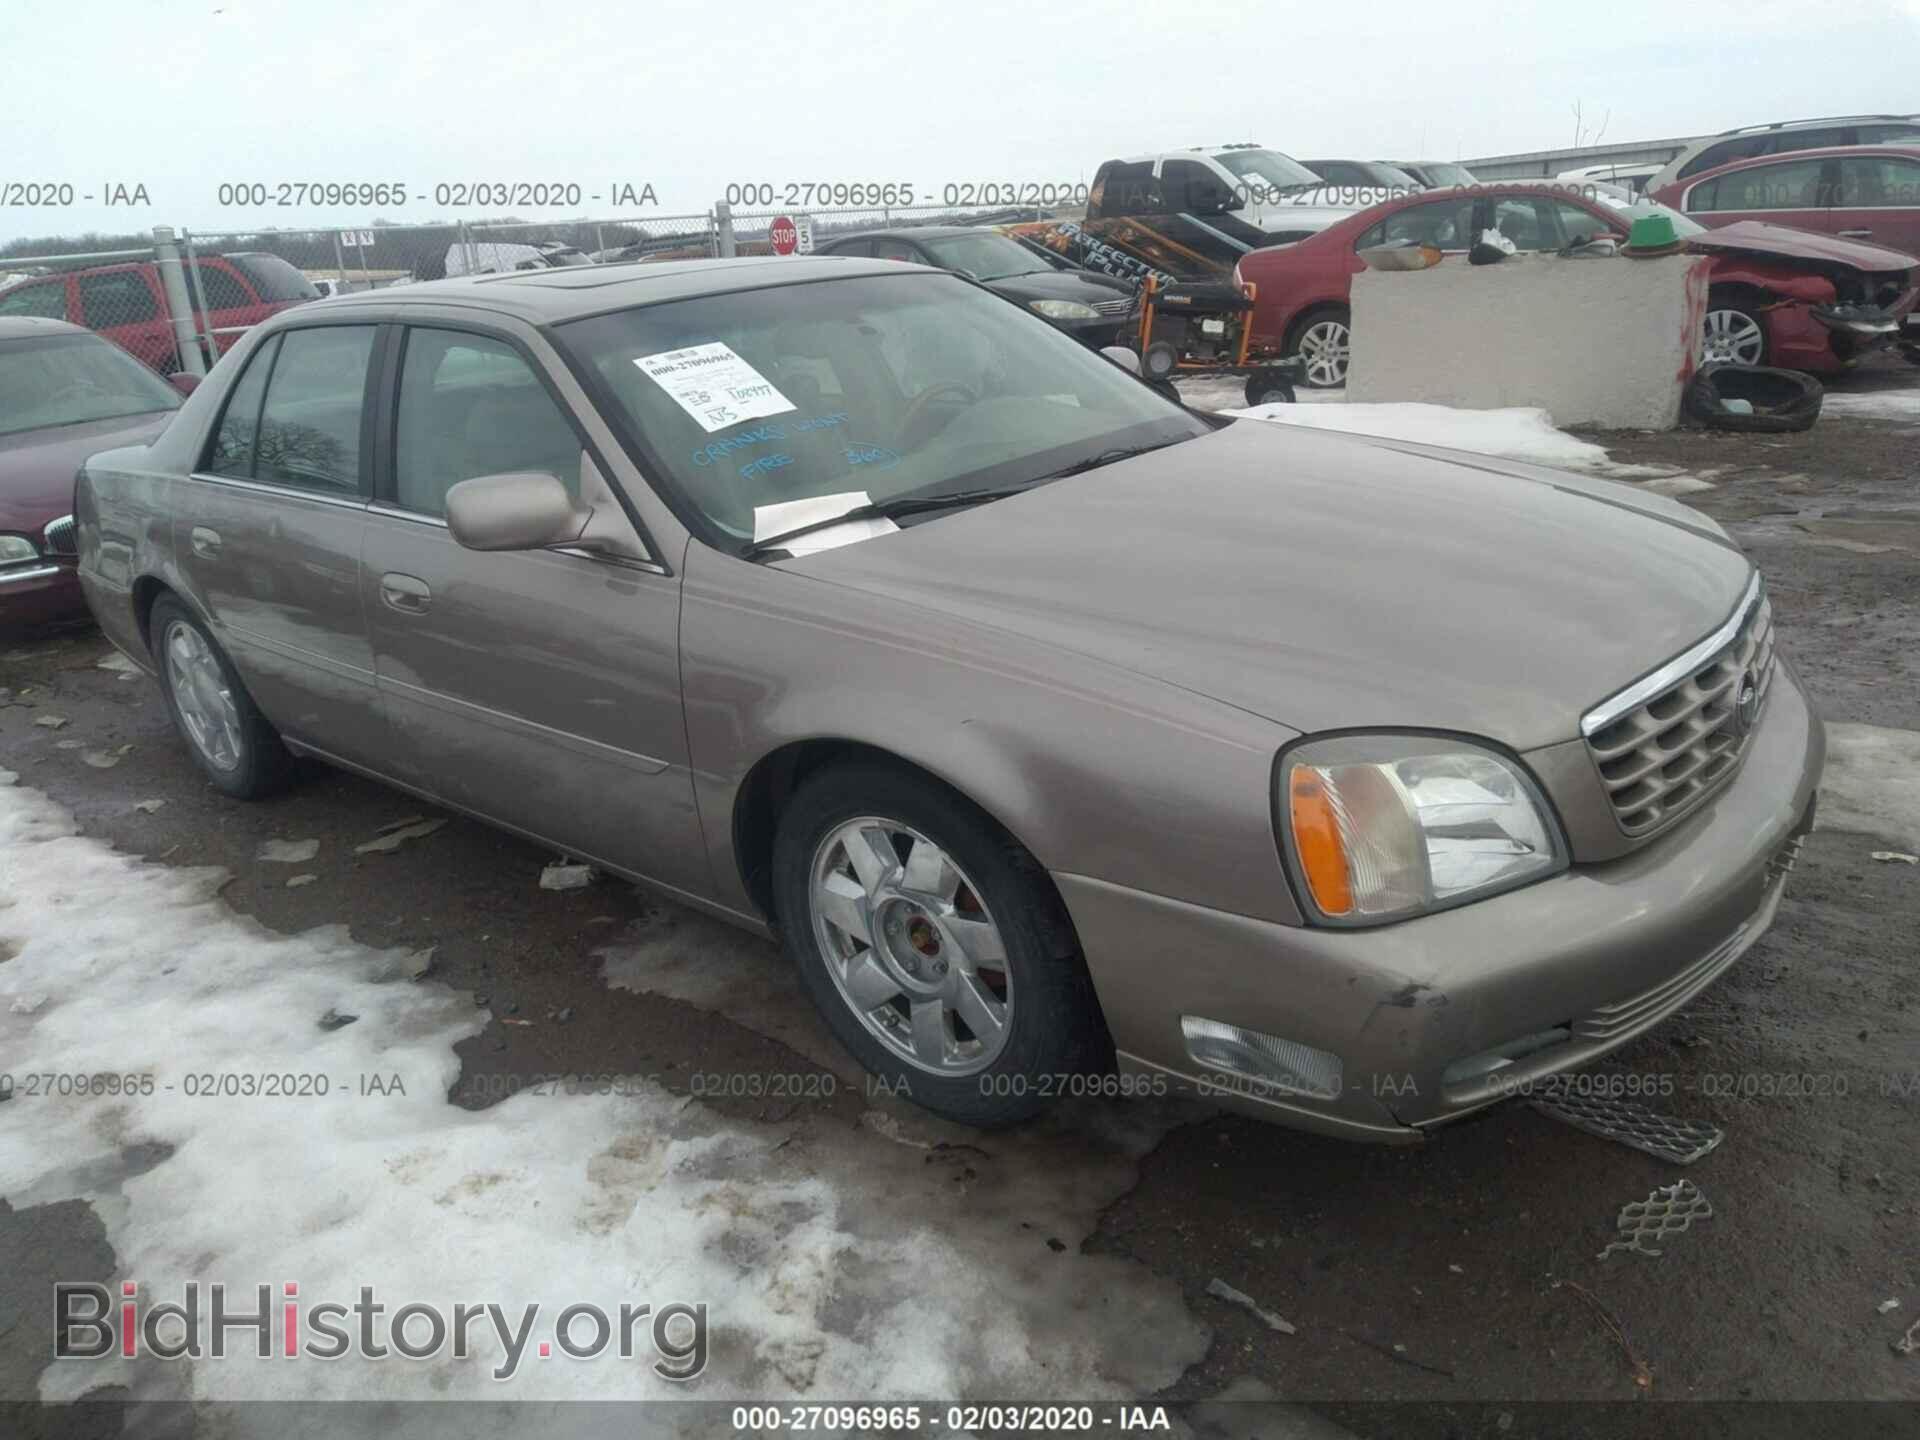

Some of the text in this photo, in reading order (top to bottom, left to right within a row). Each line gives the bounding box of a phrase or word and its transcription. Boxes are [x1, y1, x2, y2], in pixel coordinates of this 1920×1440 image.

[772, 229, 795, 245] STOP
[801, 230, 809, 244] 5
[738, 452, 795, 480] FIRE
